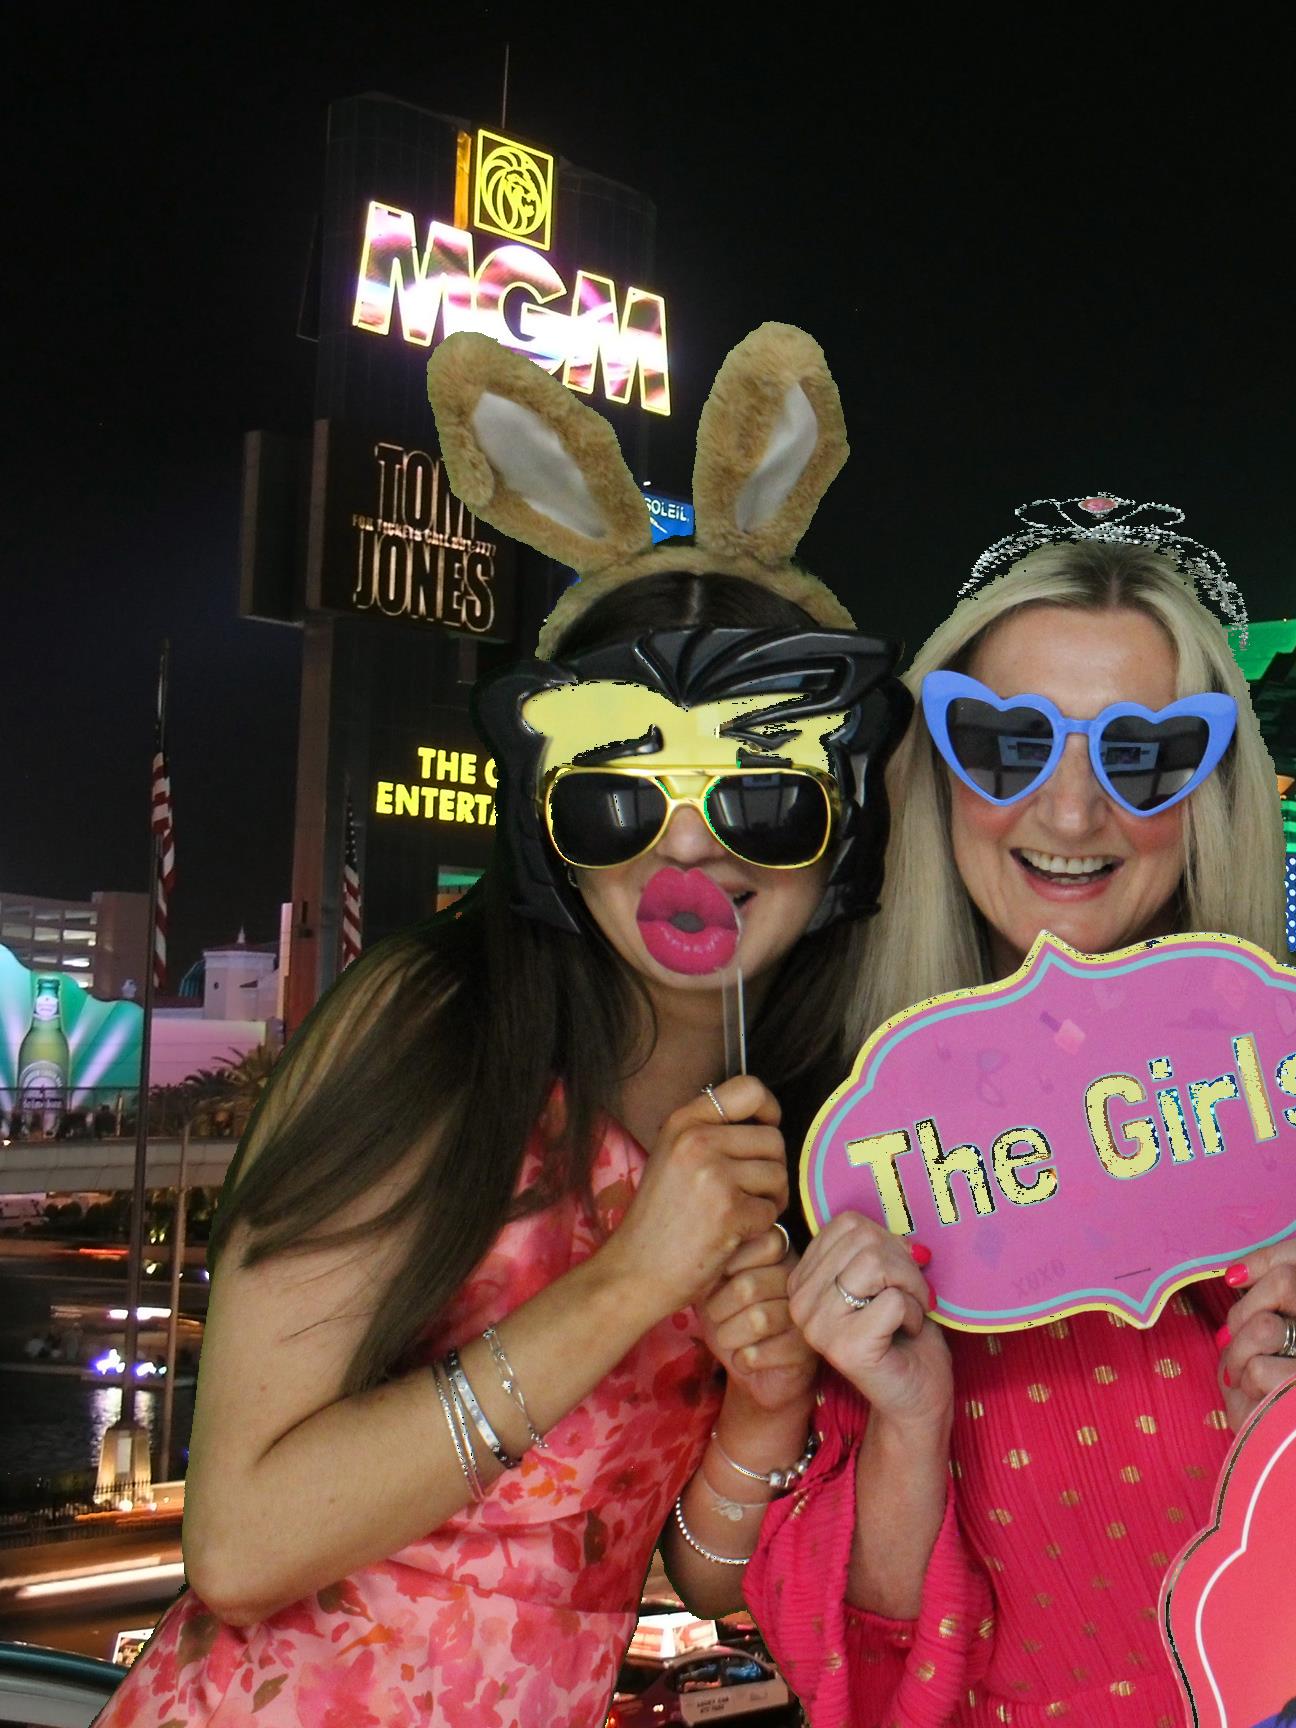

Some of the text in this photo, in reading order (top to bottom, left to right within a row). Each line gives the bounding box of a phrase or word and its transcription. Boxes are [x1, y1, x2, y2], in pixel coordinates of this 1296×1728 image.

[352, 200, 672, 417] MGM
[352, 530, 495, 633] JONES
[417, 746, 477, 785] THE
[845, 1116, 1059, 1237] The
